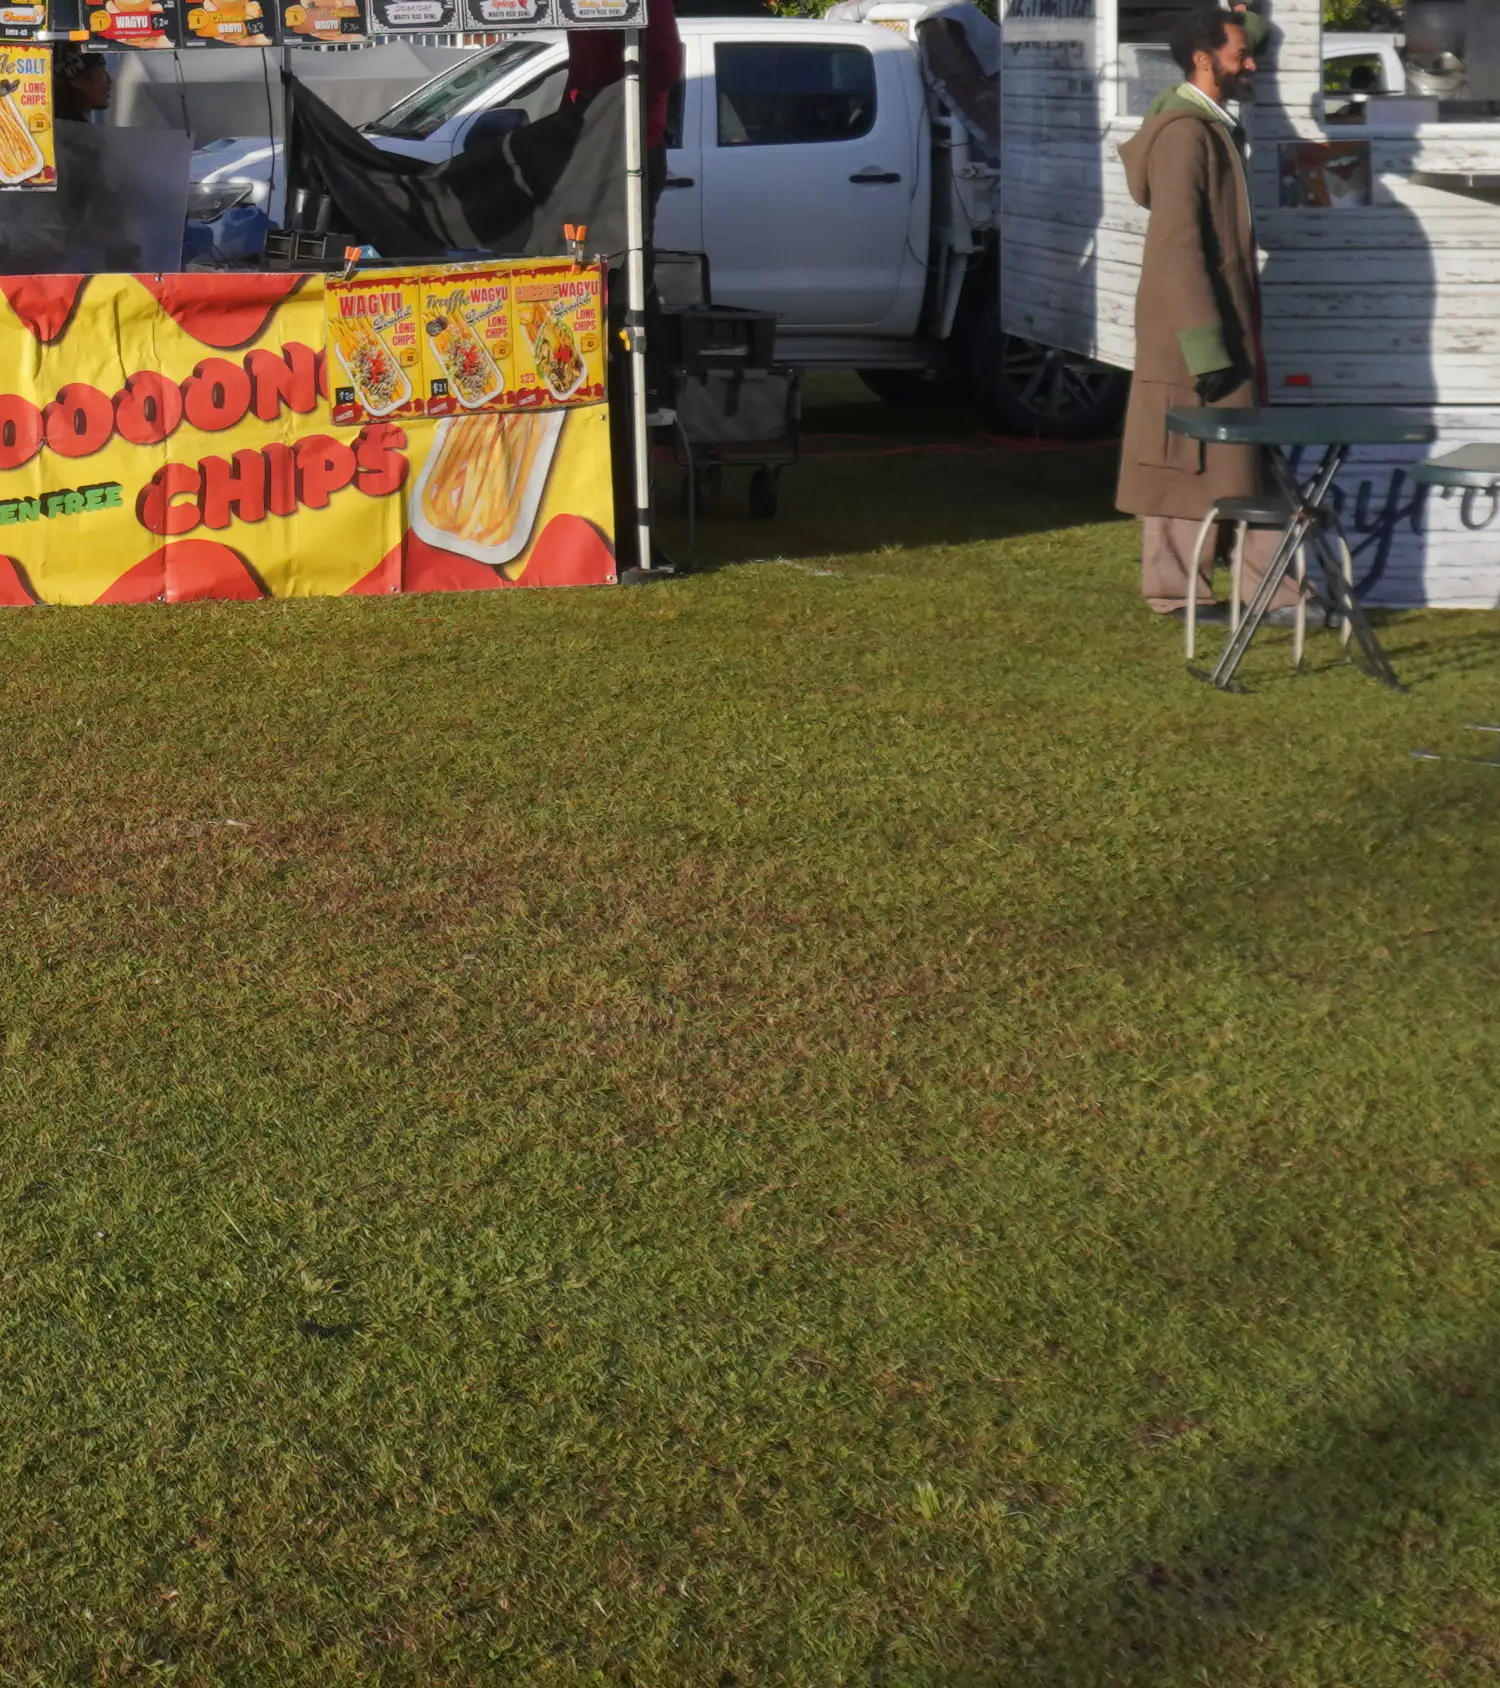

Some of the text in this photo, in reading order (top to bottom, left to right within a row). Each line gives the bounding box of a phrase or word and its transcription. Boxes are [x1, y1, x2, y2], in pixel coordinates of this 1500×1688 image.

[116, 16, 148, 29] WAGYU
[217, 23, 242, 33] WAGYU
[16, 58, 46, 74] SALT
[23, 82, 46, 93] LONG
[21, 94, 46, 105] CHIPS
[559, 281, 599, 297] WAGYU
[339, 293, 402, 317] WAGYU
[426, 286, 508, 313] Truffle WAGYU
[576, 309, 596, 320] LONG
[488, 316, 507, 327] LONG
[574, 320, 596, 331] CHIPS
[394, 323, 415, 333] LONG
[486, 328, 508, 339] CHIPS
[392, 336, 416, 346] CHIPS
[136, 423, 408, 536] CHIPS
[43, 481, 125, 520] FREE
